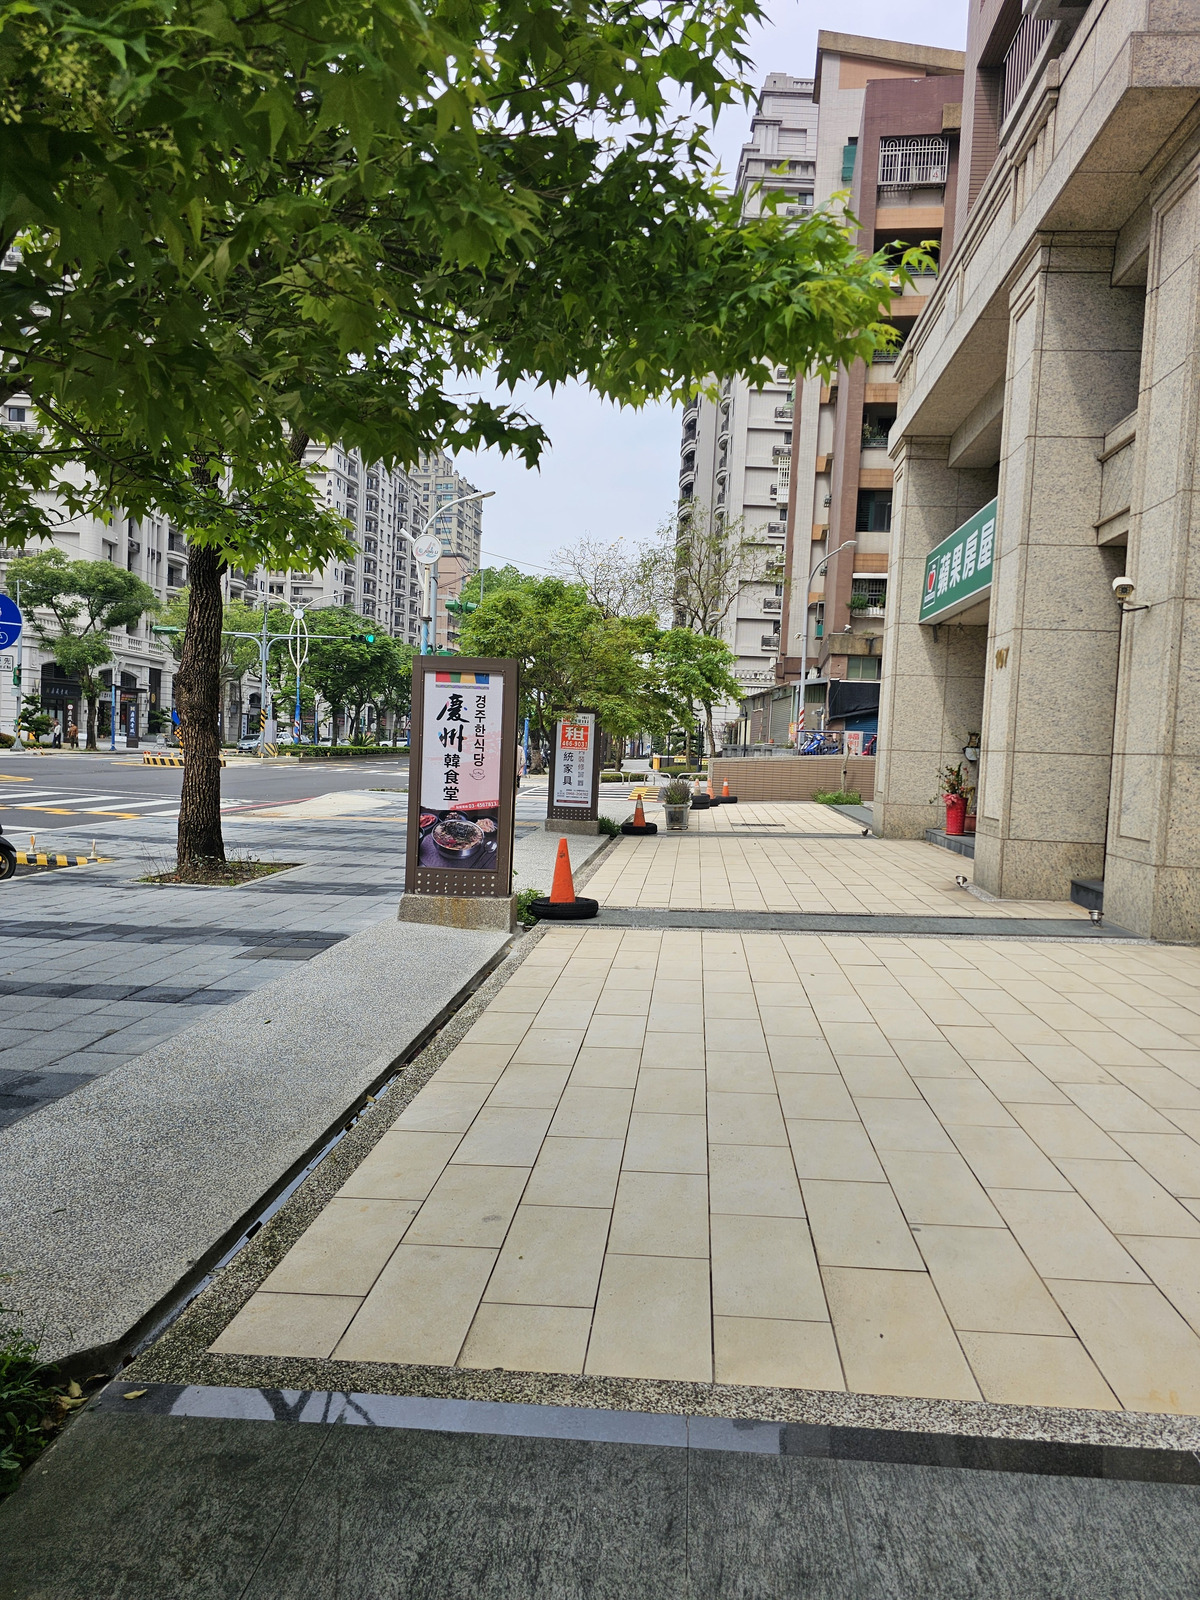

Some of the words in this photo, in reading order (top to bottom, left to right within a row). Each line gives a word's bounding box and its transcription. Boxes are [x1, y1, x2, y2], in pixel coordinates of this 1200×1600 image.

[937, 517, 995, 597] 蘋果房屋
[473, 695, 487, 767] 경주한식당
[565, 726, 585, 741] 租
